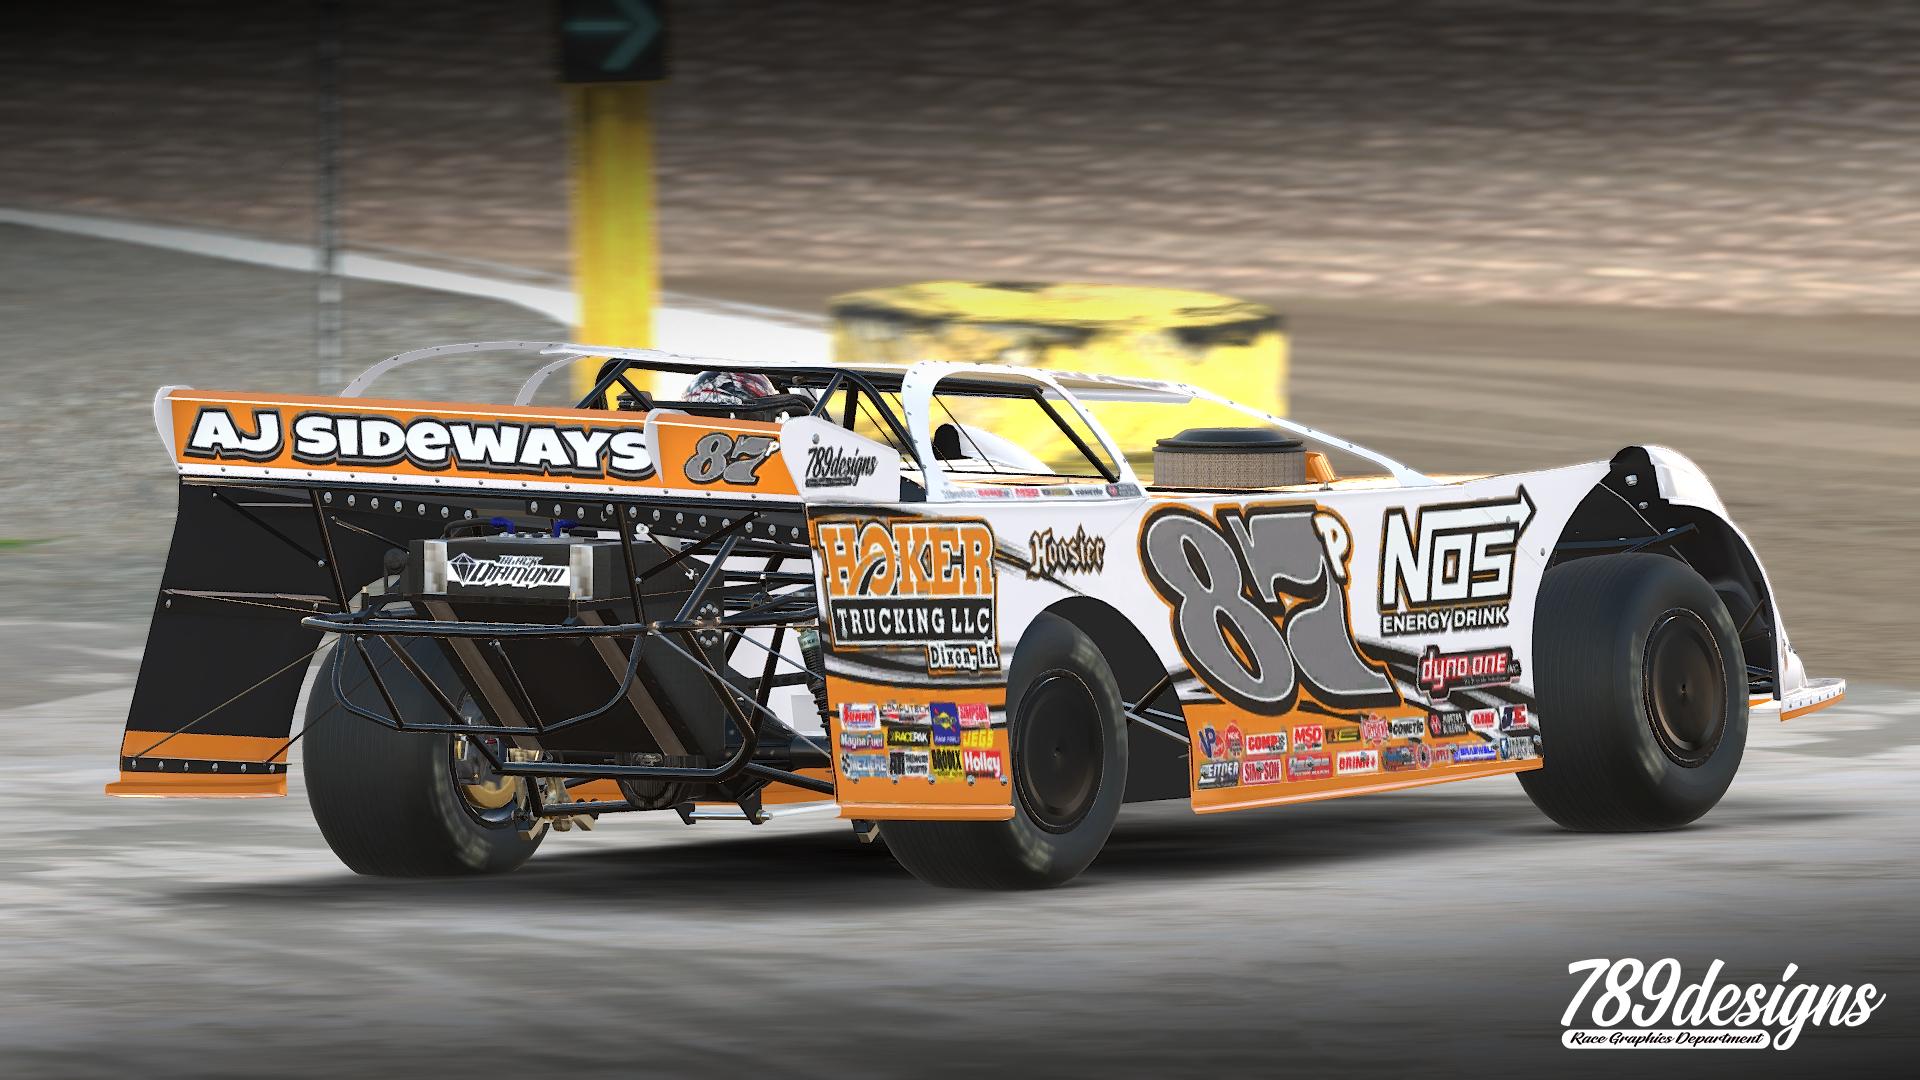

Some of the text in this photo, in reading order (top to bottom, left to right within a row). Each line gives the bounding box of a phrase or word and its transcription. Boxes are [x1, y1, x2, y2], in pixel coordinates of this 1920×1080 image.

[189, 410, 282, 459] AJ
[805, 445, 878, 486] 789designs
[818, 521, 996, 598] HOKER
[1029, 524, 1106, 580] Hoosier
[1381, 488, 1530, 611] NOS
[837, 606, 990, 638] TRUCKING LLC
[1382, 605, 1509, 636] ENERGY DRINK
[979, 642, 998, 666] IA
[1421, 650, 1468, 690] dyno
[1472, 652, 1508, 676] one
[1248, 735, 1278, 751] COMP
[1294, 726, 1322, 743] MSD
[964, 751, 1001, 777] Holley
